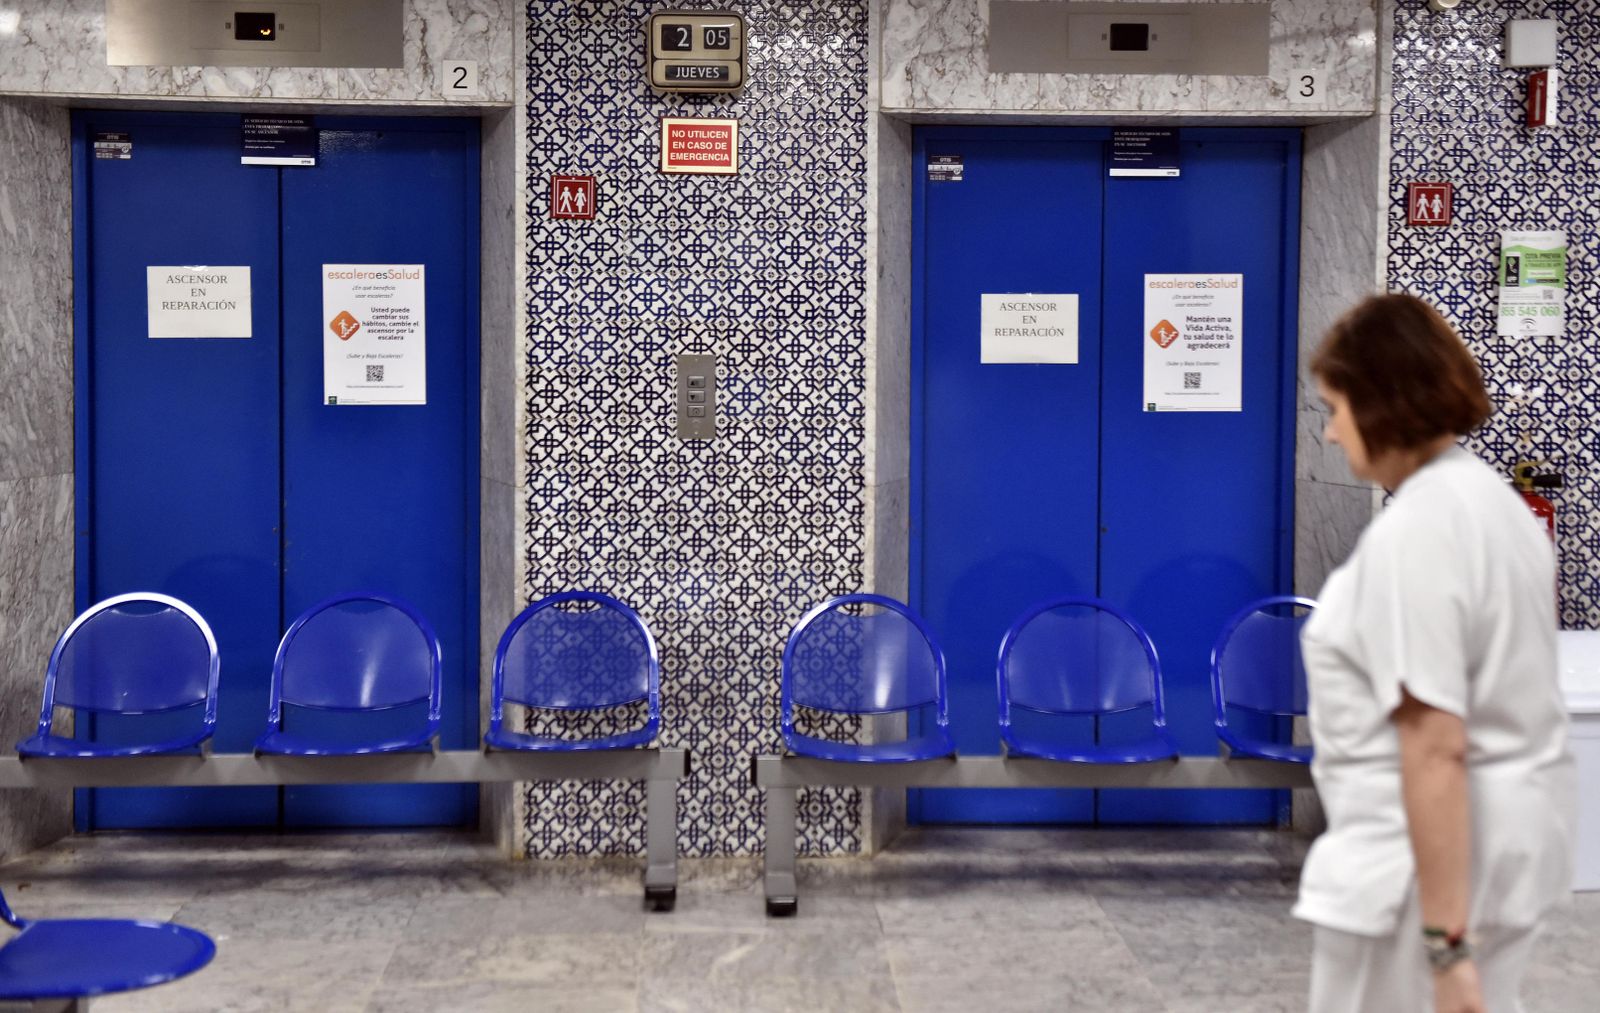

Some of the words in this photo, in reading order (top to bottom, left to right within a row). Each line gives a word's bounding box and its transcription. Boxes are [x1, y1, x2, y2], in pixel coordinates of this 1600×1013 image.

[676, 27, 690, 48] 2
[705, 29, 728, 47] 05
[452, 66, 468, 89] 2
[675, 66, 720, 79] JUEVES
[1299, 75, 1315, 98] 3
[671, 129, 686, 138] NO
[687, 130, 729, 139] UTILICEN
[672, 141, 686, 149] EN
[687, 141, 713, 150] CASO
[714, 142, 728, 150] DE
[669, 152, 730, 162] EMERGENCIA
[327, 268, 420, 280] escaleraesSalud
[166, 275, 228, 284] ASCENSOR
[1149, 278, 1238, 289] escaleraesSalud
[190, 288, 207, 297] EN
[161, 299, 237, 311] REPARACIÓN
[999, 302, 1057, 312] ASCENSOR
[1022, 315, 1037, 324] EN
[1185, 315, 1216, 323] Mantén
[994, 326, 1065, 337] REPARACIÓN
[1185, 324, 1203, 332] Vida
[1204, 324, 1232, 333] Activa,
[1183, 333, 1192, 341] tu
[1193, 333, 1215, 341] salud
[1216, 333, 1224, 341] te
[1226, 333, 1234, 341] lo
[1186, 342, 1231, 351] agradecerá
